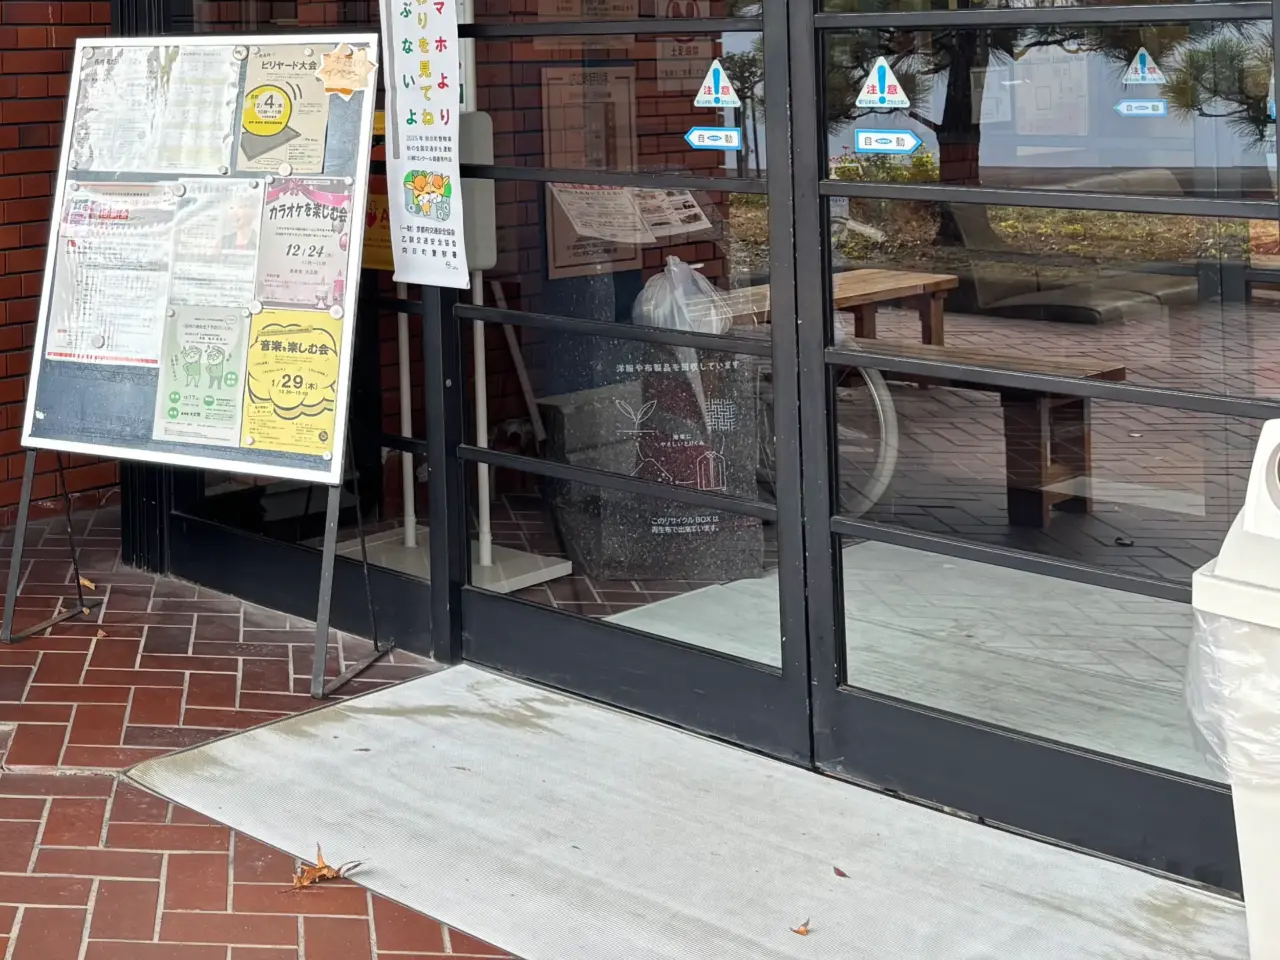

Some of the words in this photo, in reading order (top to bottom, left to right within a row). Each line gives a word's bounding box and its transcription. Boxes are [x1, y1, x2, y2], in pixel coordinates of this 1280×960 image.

[261, 60, 318, 71] ビリヤード大会
[703, 85, 730, 96] 注意
[866, 84, 898, 95] 注意
[697, 133, 733, 144] 自動
[864, 136, 906, 147] 自動
[269, 202, 348, 223] カラオケを楽しむ会
[260, 339, 330, 355] 音楽を楽しむ会
